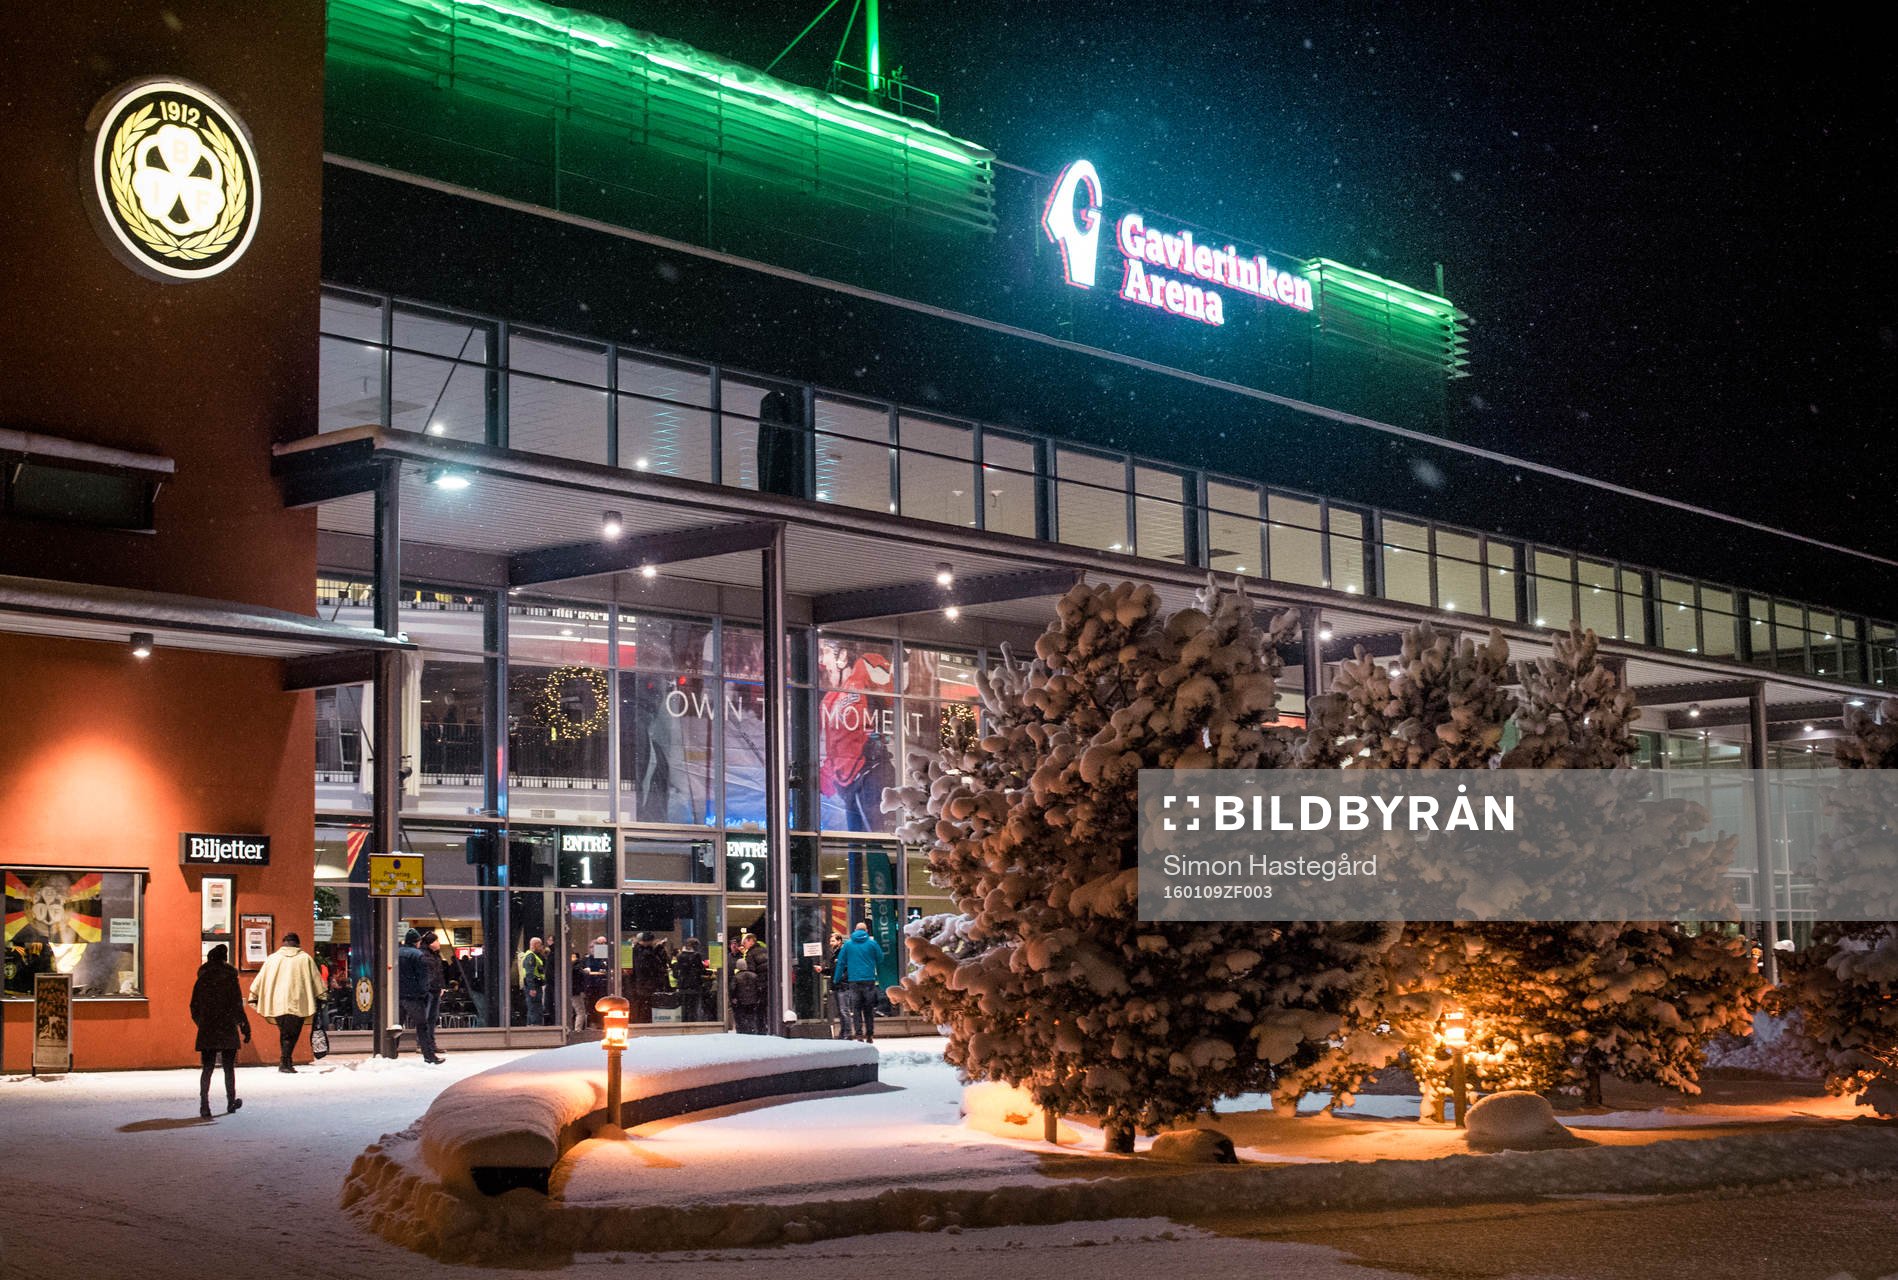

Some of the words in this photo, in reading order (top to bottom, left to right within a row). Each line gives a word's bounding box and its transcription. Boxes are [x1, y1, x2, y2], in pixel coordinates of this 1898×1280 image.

[159, 100, 201, 128] 1912
[1117, 213, 1313, 312] Gavlerinken
[1120, 258, 1224, 326] Arena
[665, 690, 743, 722] OWN
[821, 703, 924, 737] MOMENT
[190, 837, 265, 863] Biljetter
[579, 856, 593, 884] 1
[741, 862, 756, 888] 2
